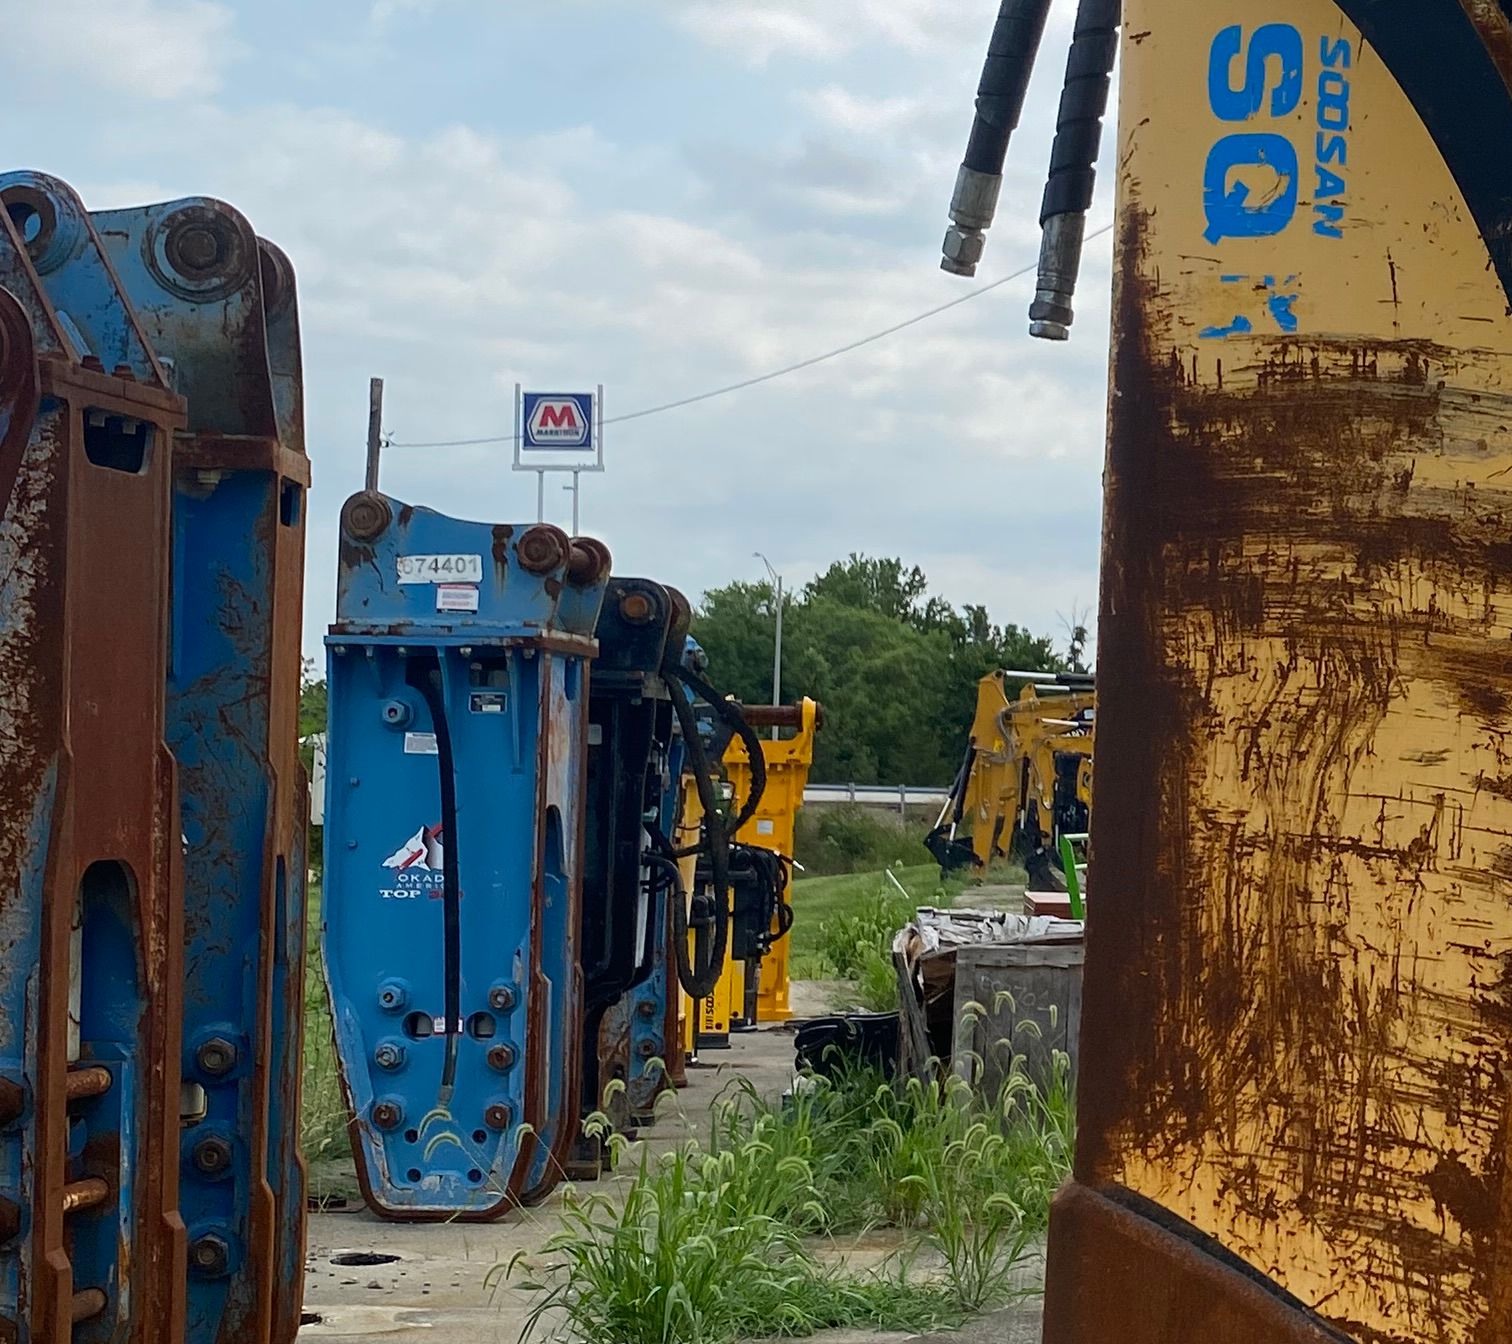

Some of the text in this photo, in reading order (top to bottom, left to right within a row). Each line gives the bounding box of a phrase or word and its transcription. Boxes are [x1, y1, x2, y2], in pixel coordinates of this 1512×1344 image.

[1202, 22, 1305, 246] SQ
[1312, 35, 1352, 239] SOOSAN
[539, 404, 577, 428] M
[398, 874, 444, 883] OKAD
[380, 889, 421, 899] TOP
